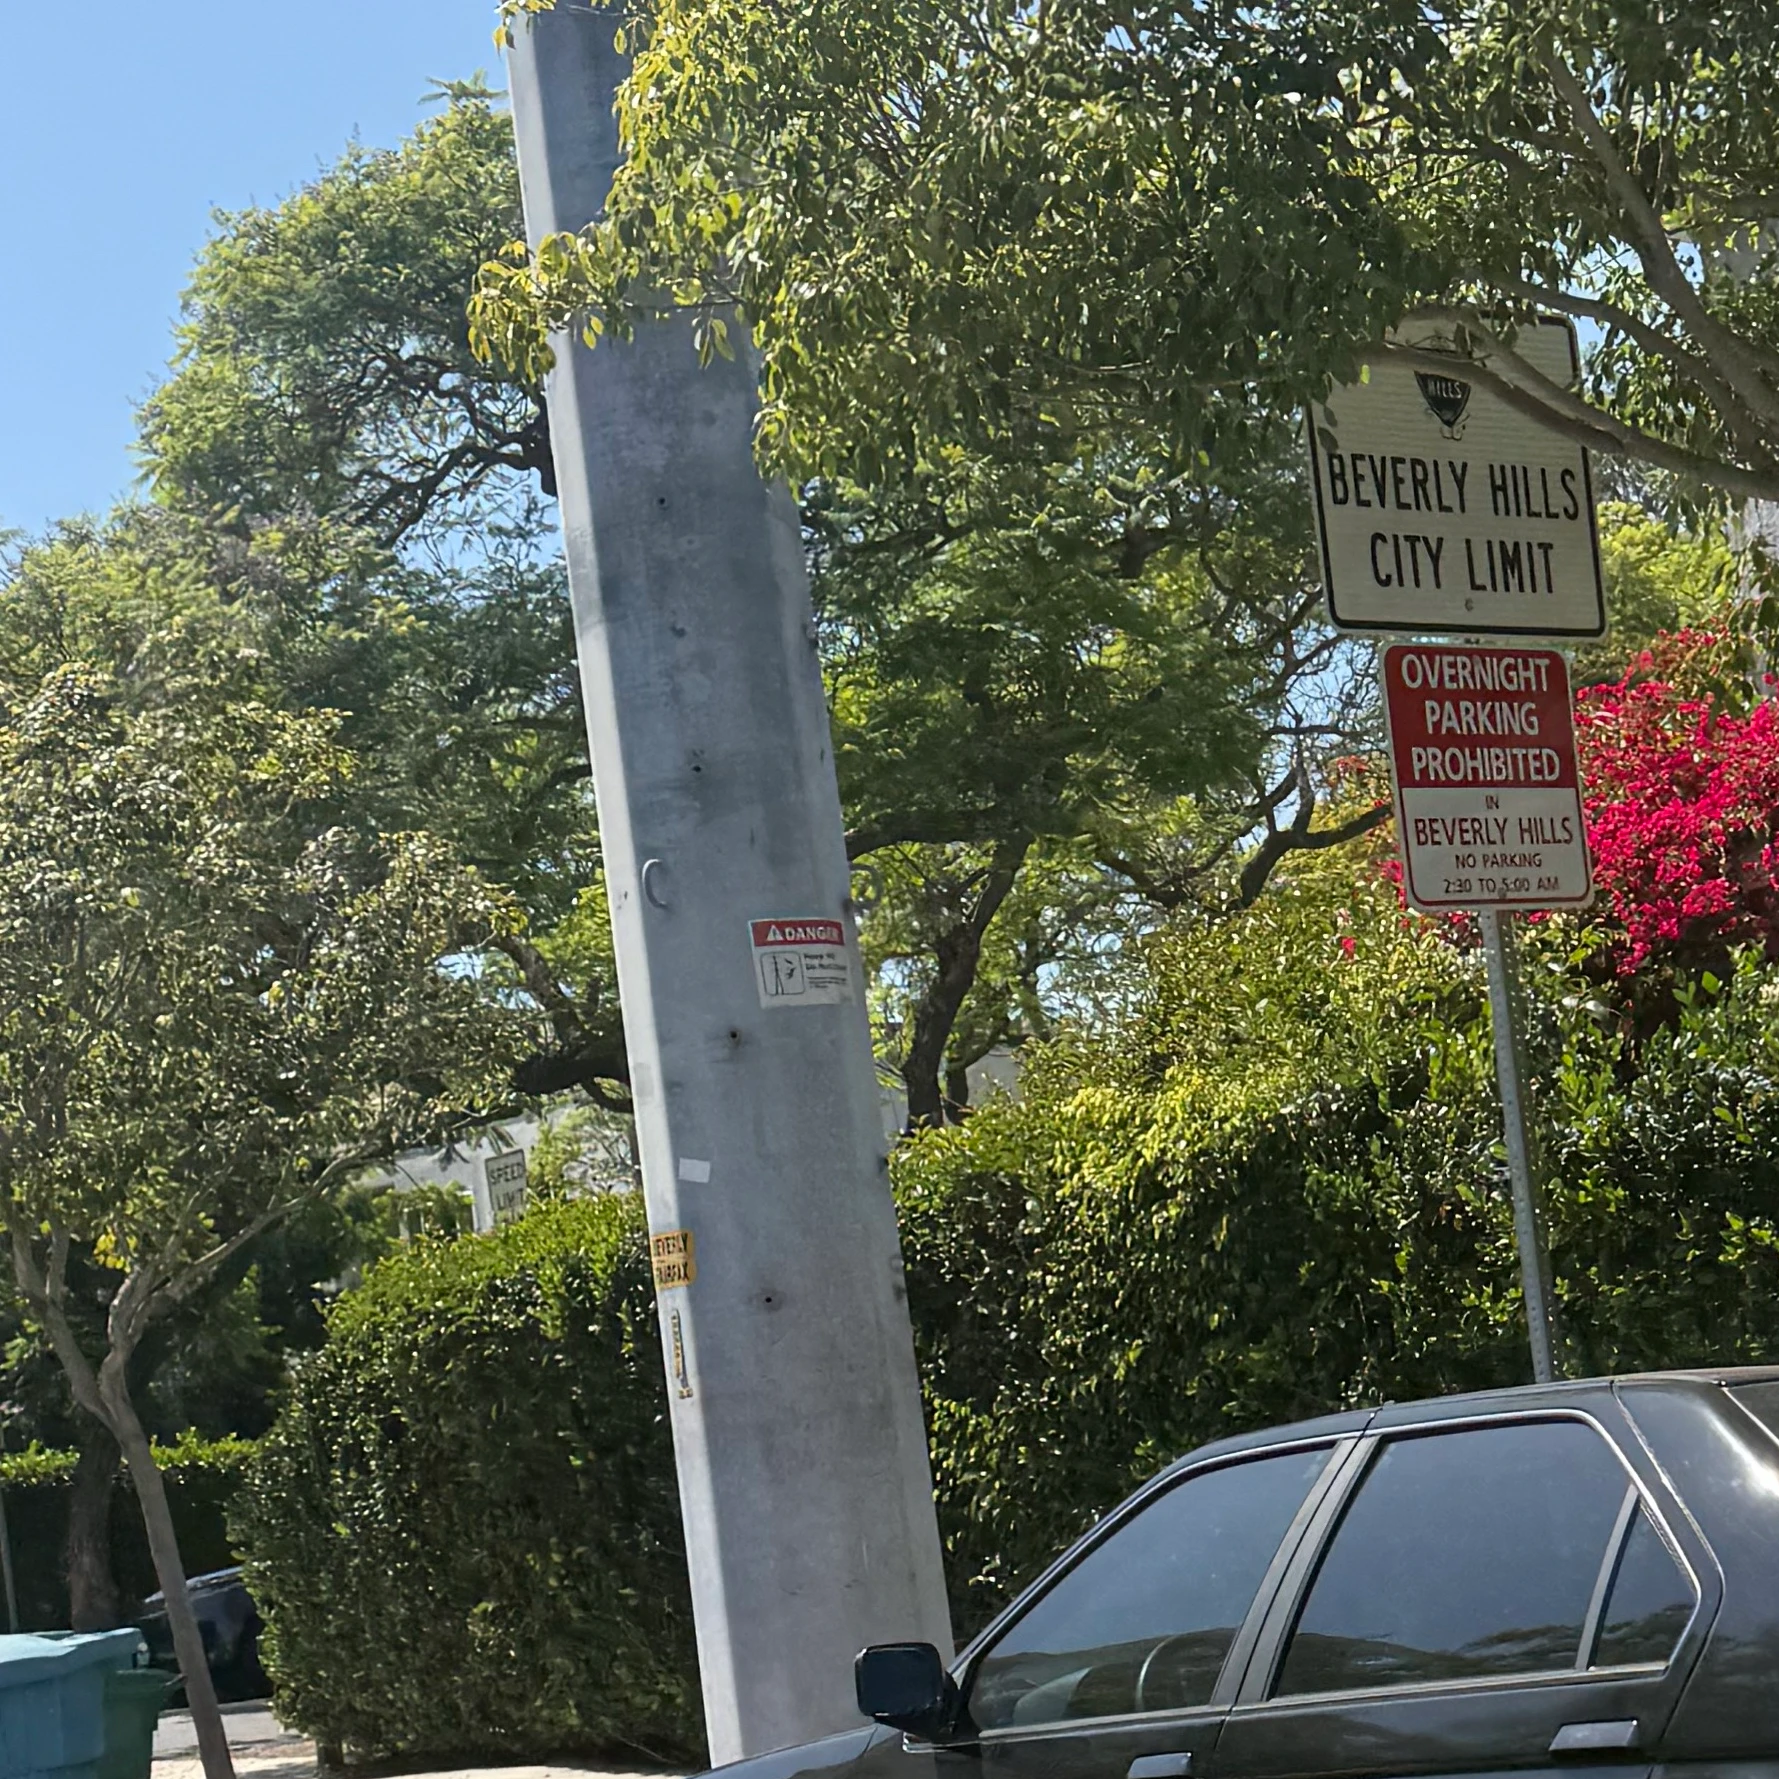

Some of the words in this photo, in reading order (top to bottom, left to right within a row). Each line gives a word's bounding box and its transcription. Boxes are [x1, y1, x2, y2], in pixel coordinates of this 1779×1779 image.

[1427, 380, 1462, 399] HILLS
[1329, 453, 1467, 514] BEVERLY
[1489, 463, 1579, 521] HILLS
[1370, 532, 1443, 589] CITY
[1465, 538, 1553, 593] LIMIT
[1401, 653, 1550, 692] OVERNIGHT
[1425, 700, 1539, 735] PARKING
[1411, 747, 1560, 781] PROHIBITED
[1485, 795, 1500, 810] IN
[1414, 817, 1508, 846] BEVERLY
[1519, 816, 1573, 845] HILLS
[1455, 853, 1477, 869] NO
[1482, 852, 1543, 868] PARKING
[1443, 878, 1472, 893] 2:30
[1478, 878, 1496, 893] TO
[1502, 877, 1530, 893] 5:00
[1537, 876, 1560, 892] AM
[785, 926, 839, 941] DANGER
[489, 1162, 525, 1185] SPEED
